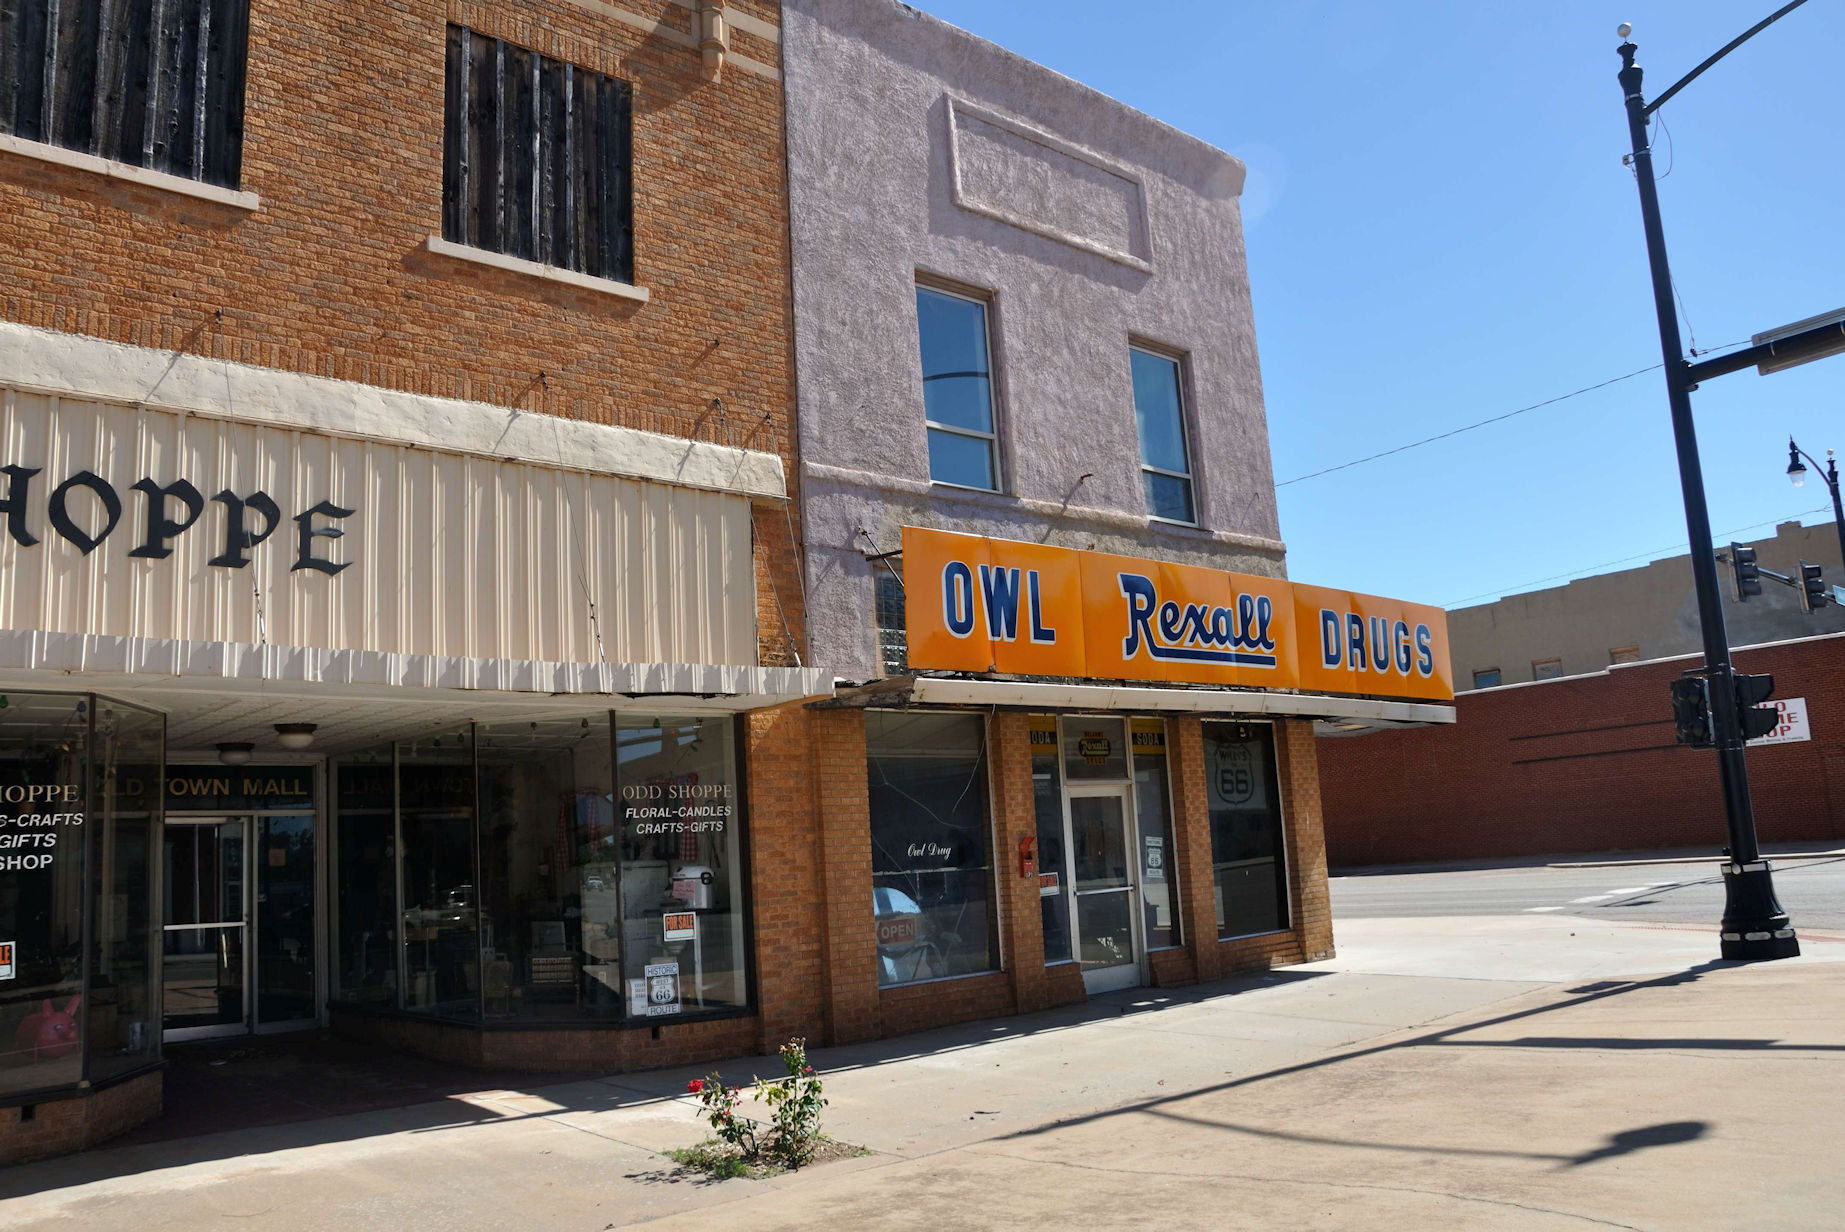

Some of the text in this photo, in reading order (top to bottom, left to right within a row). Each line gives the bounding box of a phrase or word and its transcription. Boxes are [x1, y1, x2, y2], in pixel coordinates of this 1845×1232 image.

[941, 560, 1435, 678] OWL Rexall DRUGS
[1032, 731, 1051, 744] ODA
[1136, 732, 1160, 746] SODA
[1081, 740, 1108, 755] Rexall
[242, 778, 308, 796] MALL
[1221, 769, 1248, 794] 66
[622, 784, 733, 800] ODD SHOPPE
[625, 805, 732, 819] FLORAL-CANDLES
[636, 821, 724, 835] CRAFTS-GIFTS
[0, 833, 57, 849] GIFTS
[907, 842, 952, 860] Owl Drug
[665, 914, 694, 931] FOR SALE
[881, 922, 914, 939] OPEN
[647, 966, 678, 976] HISTORIC
[656, 989, 671, 1001] 66
[650, 1004, 677, 1016] ROUTE
